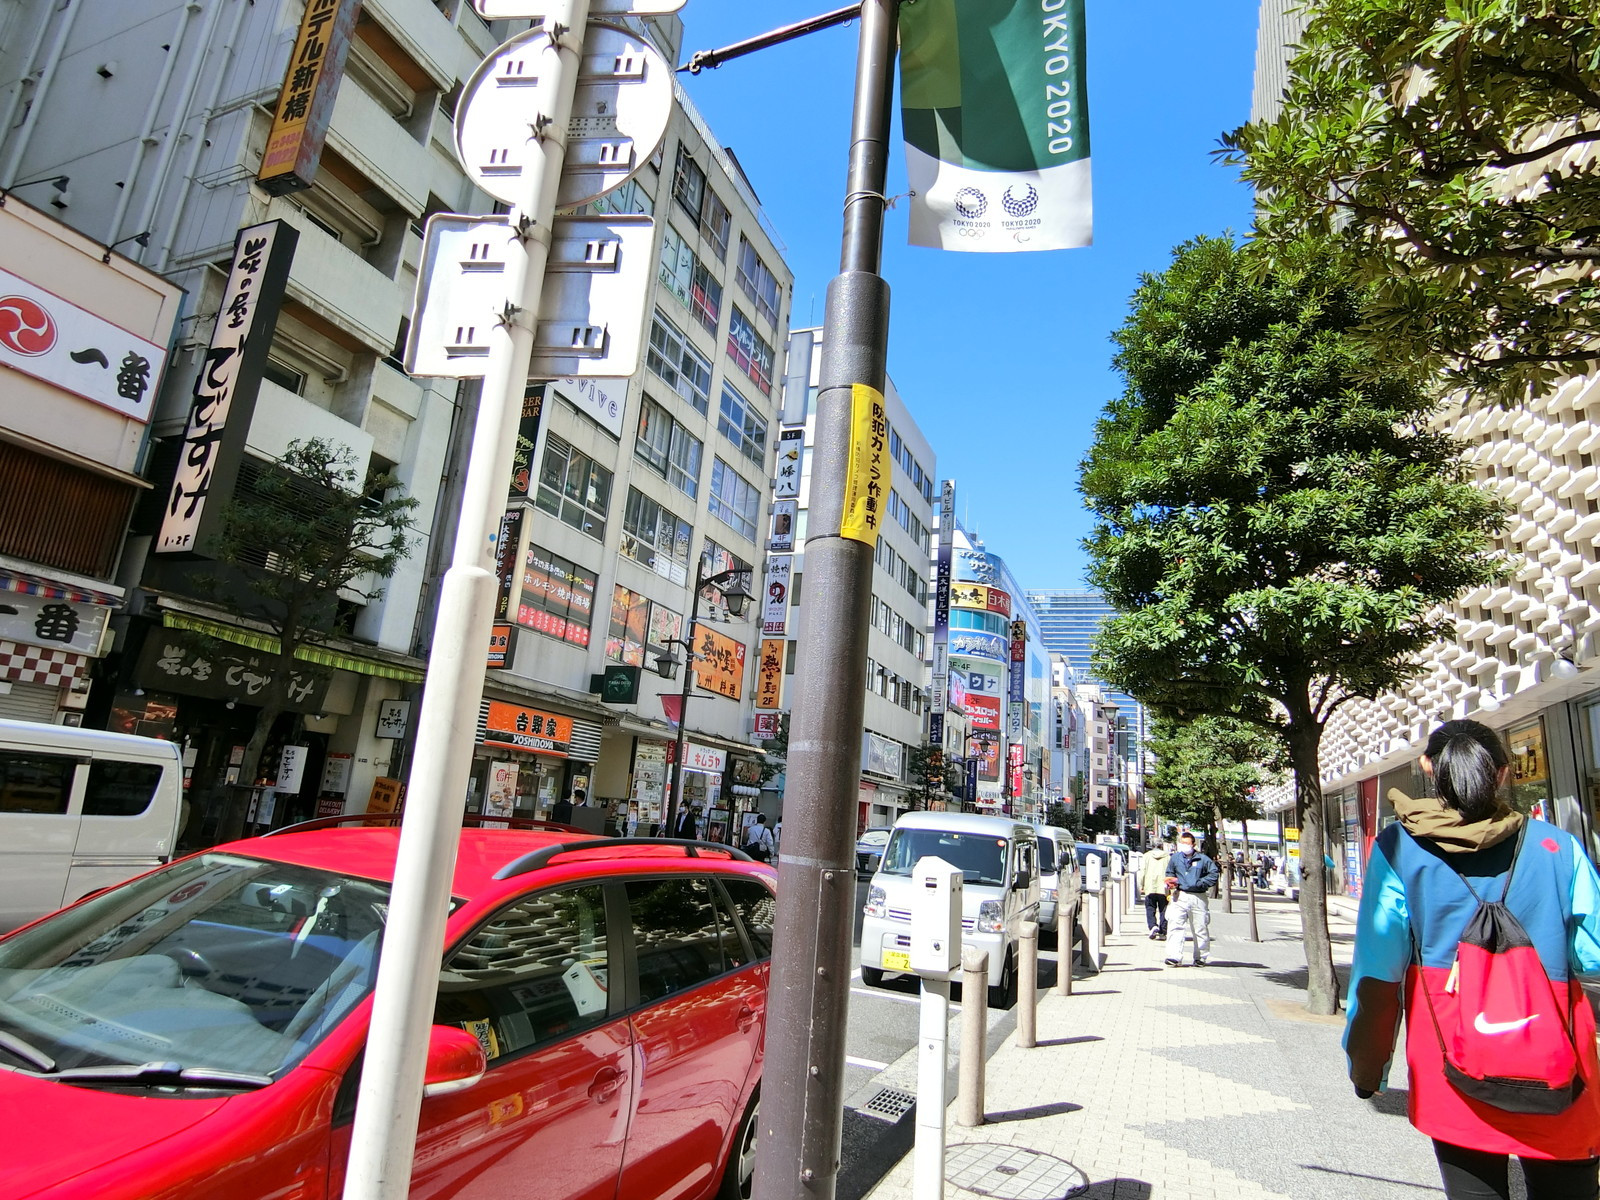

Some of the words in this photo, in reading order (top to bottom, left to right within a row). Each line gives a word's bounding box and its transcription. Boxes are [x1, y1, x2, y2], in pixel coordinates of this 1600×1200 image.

[1045, 81, 1072, 155] 2020
[953, 219, 974, 228] TOKYO
[1001, 219, 1024, 228] TOKYO
[1024, 218, 1042, 226] 2020
[70, 347, 151, 403] 一番
[523, 396, 541, 407] EER
[521, 407, 540, 417] BAR
[865, 402, 885, 530] 防犯カメラ作動中
[943, 482, 952, 511] 大洋ビル
[968, 560, 996, 573] サウナ
[524, 573, 591, 610] ホルモン焼肉酒場
[938, 578, 949, 609] 大洋ビル
[500, 596, 508, 613] 2F
[988, 591, 1011, 611] 白木屋
[489, 635, 507, 648] 野家
[736, 643, 744, 659] 2F
[220, 656, 315, 703] ででけ
[761, 654, 781, 695] 熱中屋
[1012, 662, 1022, 702] カラオケの鉄人
[763, 696, 774, 706] 2F
[516, 712, 558, 737] 吉野家
[512, 735, 554, 750] YOSHINOYA
[694, 752, 721, 769] キムラヤ
